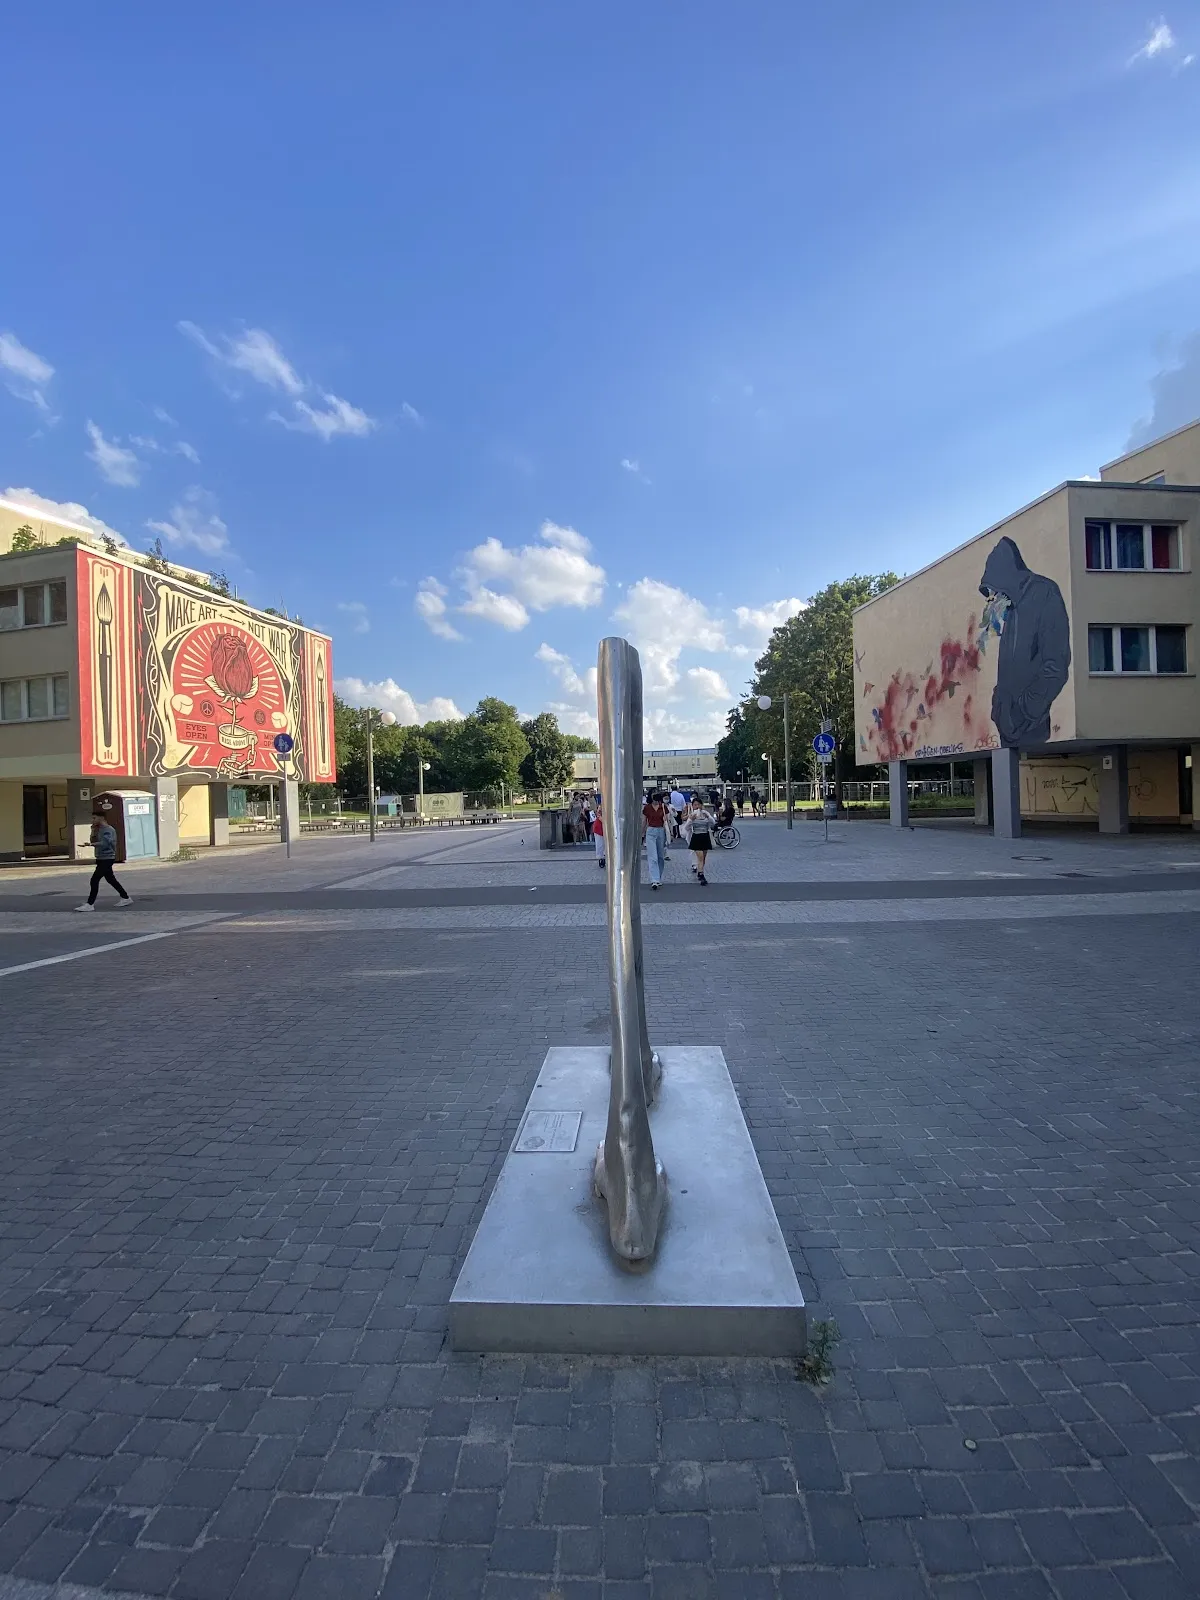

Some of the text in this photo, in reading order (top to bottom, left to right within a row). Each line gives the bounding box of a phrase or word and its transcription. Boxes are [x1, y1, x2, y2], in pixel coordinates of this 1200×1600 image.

[166, 592, 217, 638] MAKE ART
[248, 620, 287, 669] NOT WAR
[186, 723, 207, 732] EYES
[186, 731, 208, 740] OPEN
